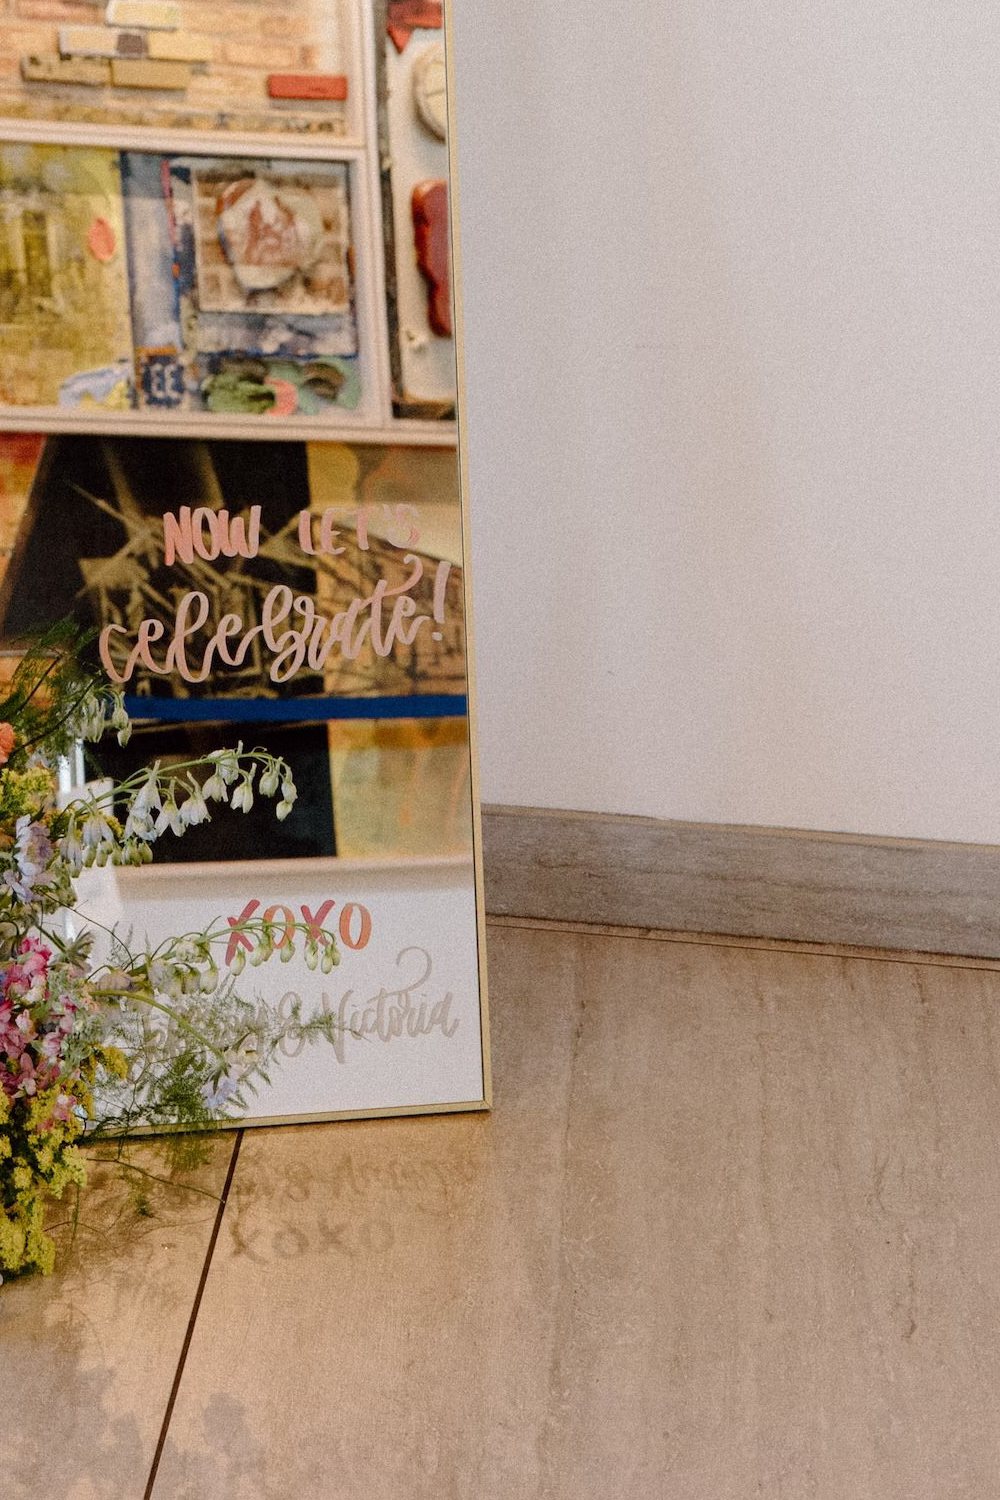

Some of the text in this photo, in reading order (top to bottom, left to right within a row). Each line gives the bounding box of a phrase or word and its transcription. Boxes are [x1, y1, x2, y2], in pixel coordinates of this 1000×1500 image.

[163, 503, 421, 566] NOW LET'S
[99, 554, 452, 684] celebrate!
[225, 899, 372, 966] XOXO
[322, 946, 461, 1064] Victoria
